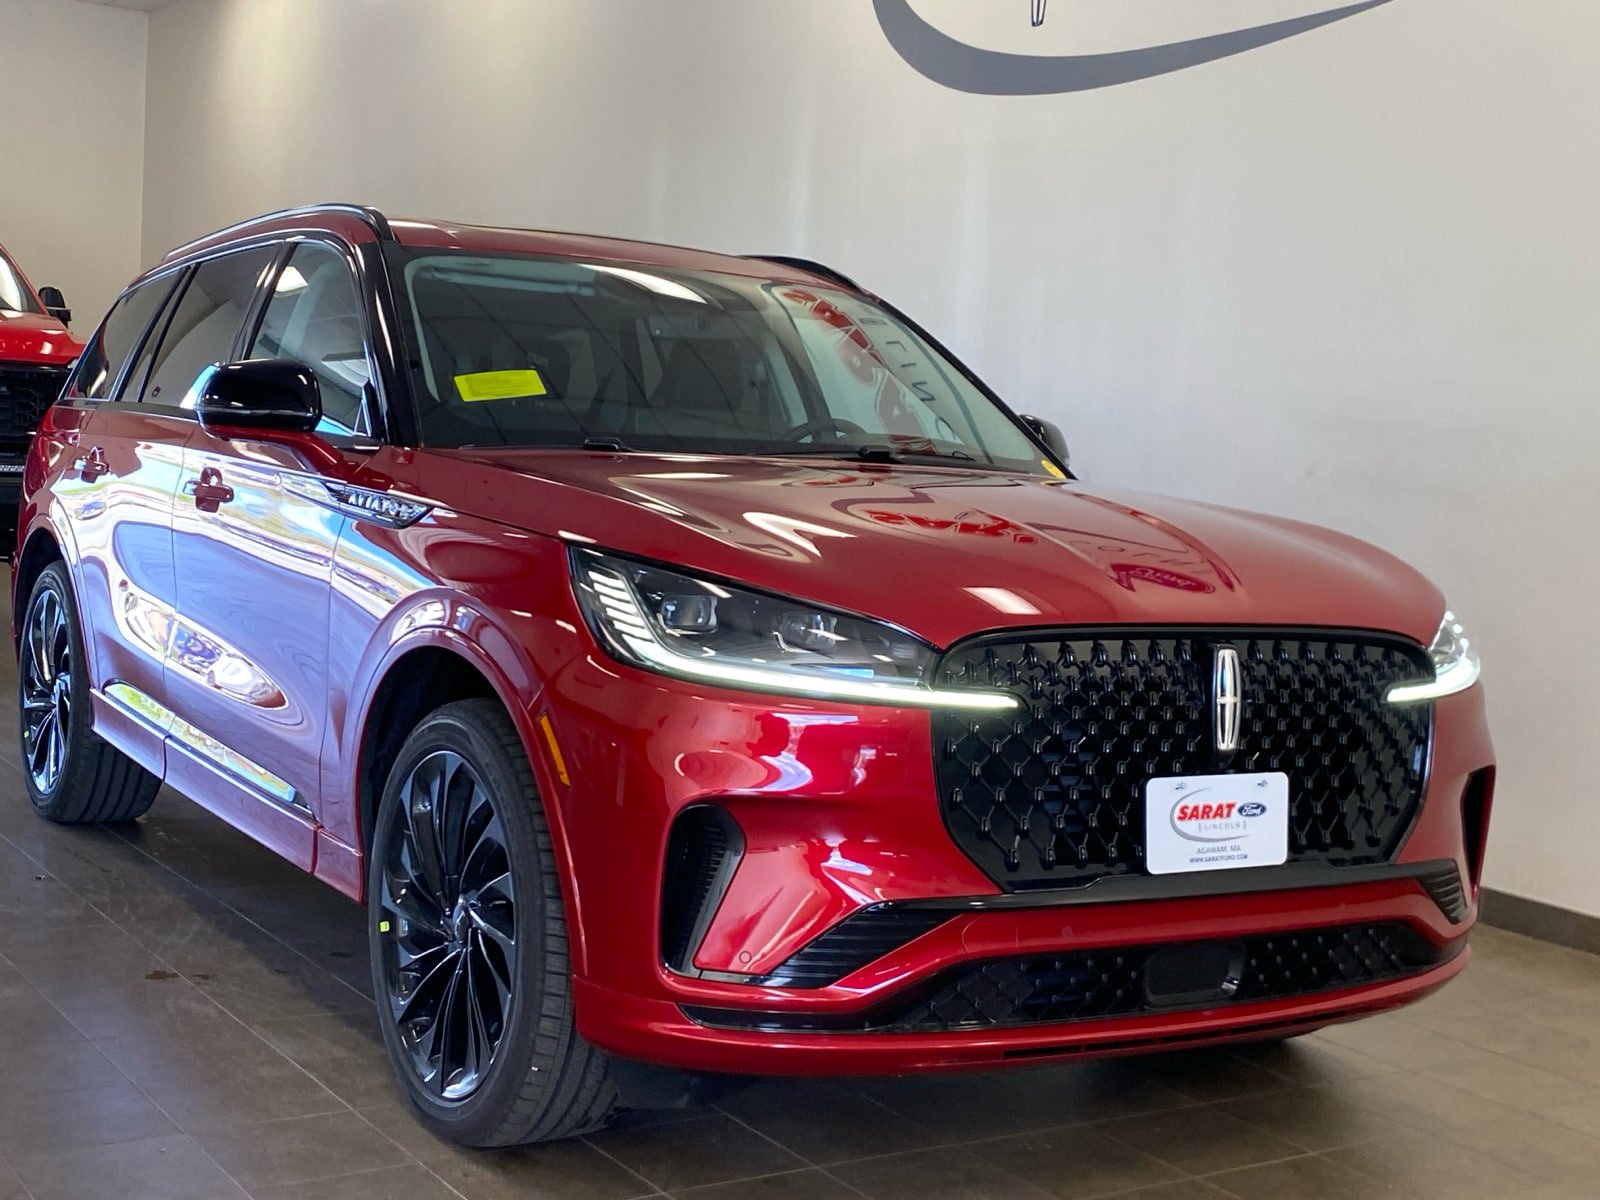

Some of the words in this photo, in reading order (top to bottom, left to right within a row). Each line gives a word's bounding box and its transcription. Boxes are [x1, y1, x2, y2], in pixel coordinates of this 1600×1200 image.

[1177, 803, 1236, 821] SARAT
[1240, 803, 1264, 816] Ford
[1204, 822, 1241, 831] LINCOLN
